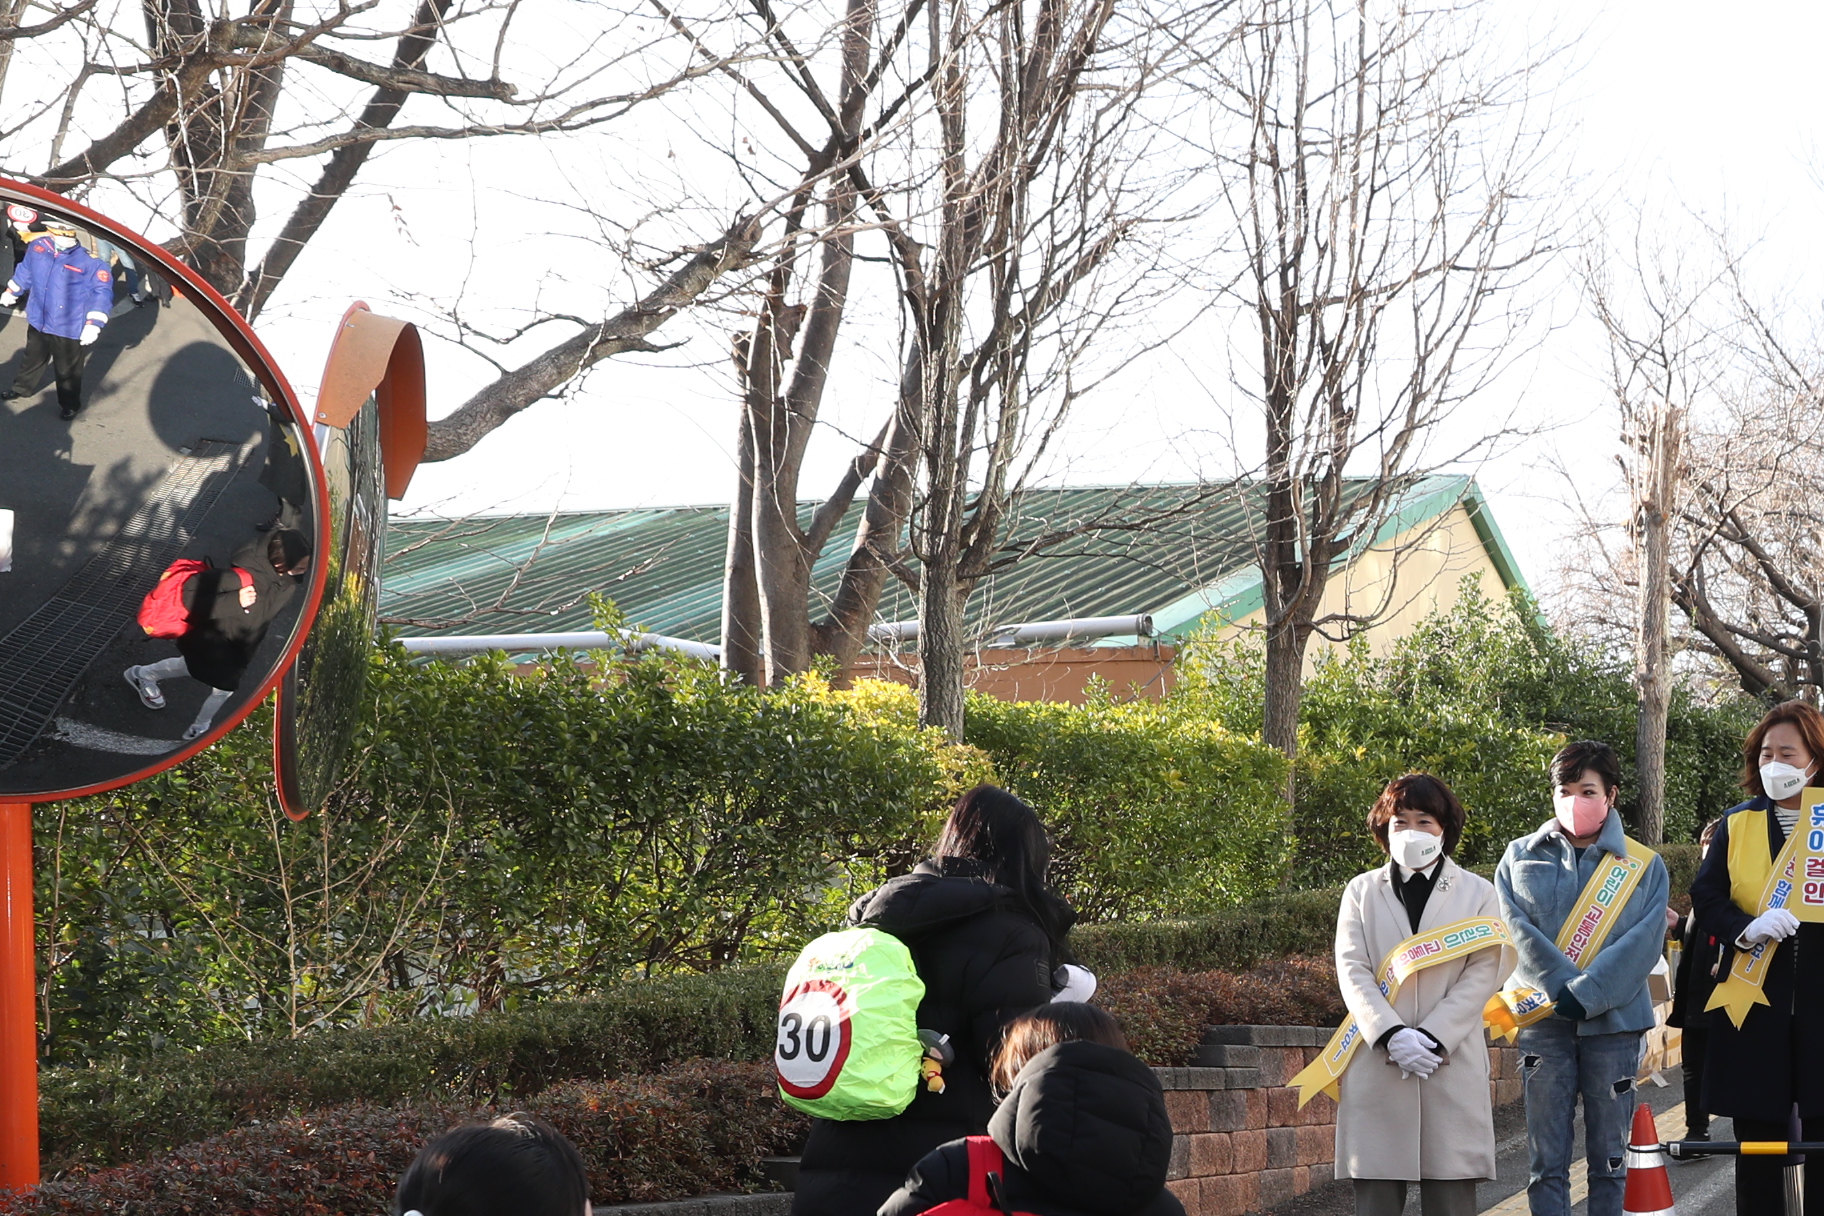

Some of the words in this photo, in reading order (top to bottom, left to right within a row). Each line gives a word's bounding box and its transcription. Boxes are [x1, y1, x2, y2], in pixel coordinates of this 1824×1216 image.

[1597, 866, 1628, 907] 어린이
[1444, 926, 1493, 948] 어린이
[779, 1013, 831, 1062] 30
